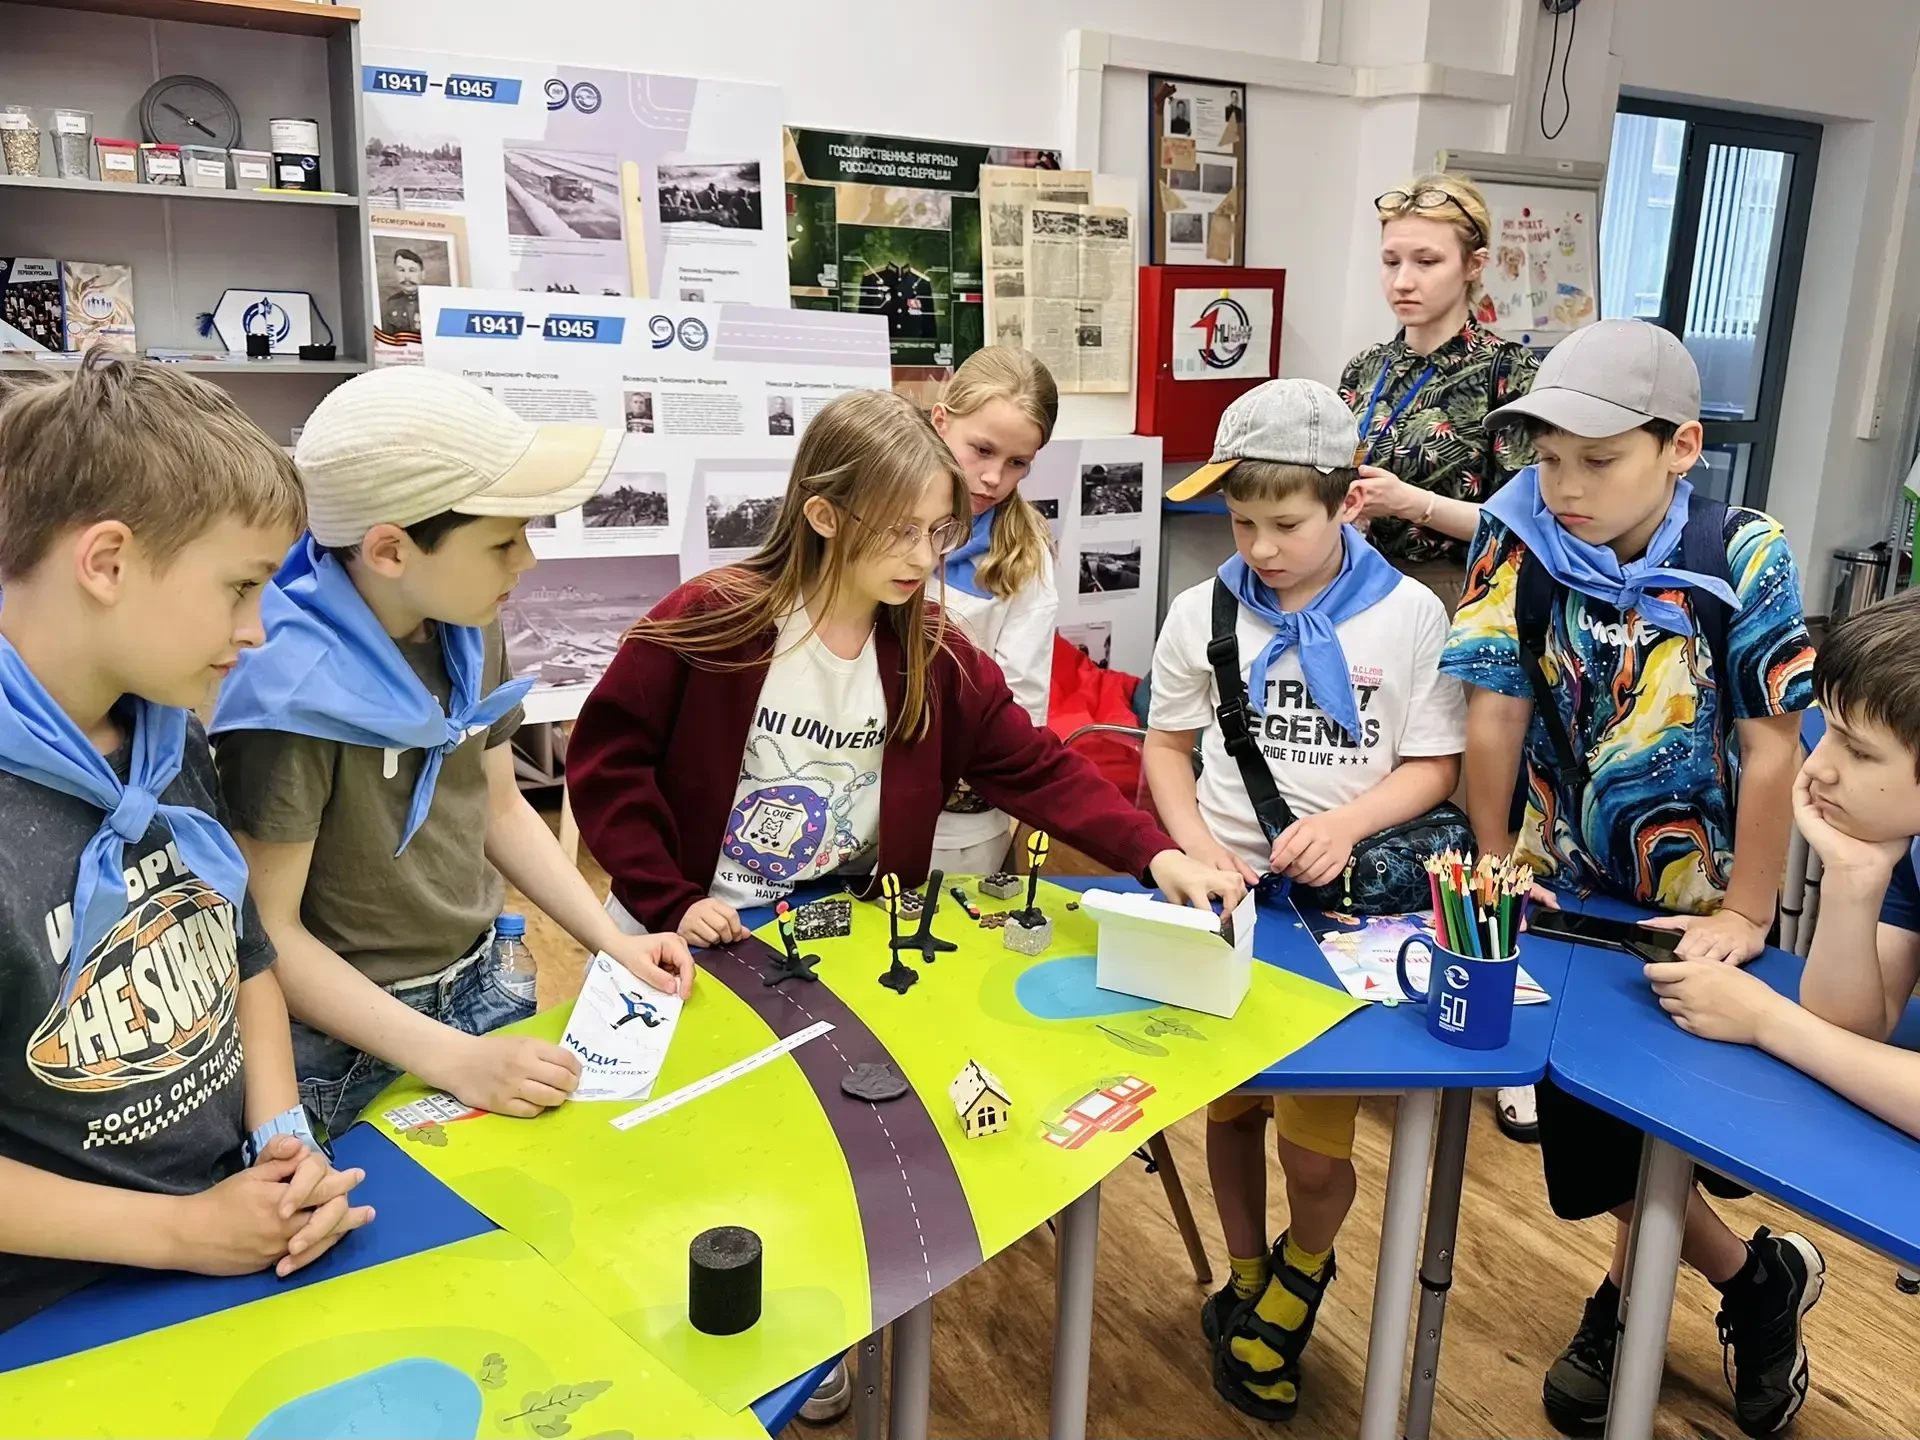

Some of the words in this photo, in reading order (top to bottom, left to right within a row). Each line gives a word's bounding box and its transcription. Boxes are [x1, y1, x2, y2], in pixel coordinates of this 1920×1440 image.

[377, 73, 422, 92] 1941
[448, 79, 493, 98] 1945
[828, 144, 915, 164] ГОСУДАРСТВЕННЫЕ
[916, 153, 959, 167] НАГРАДЫ
[839, 160, 896, 176] РОССИЙСКОЙ
[897, 166, 952, 181] ФЕДЕРАЦИИ
[371, 215, 425, 228] Бессмертный
[470, 315, 519, 335] 1941
[547, 319, 595, 338] 1945
[755, 706, 787, 735] NI
[1262, 744, 1287, 761] RIDE
[1291, 749, 1306, 763] TO
[1309, 752, 1334, 766] LIVE
[736, 873, 763, 886] YOUR
[88, 1093, 162, 1131] FOCUS
[170, 1072, 197, 1101] ON
[200, 1048, 226, 1080] THE
